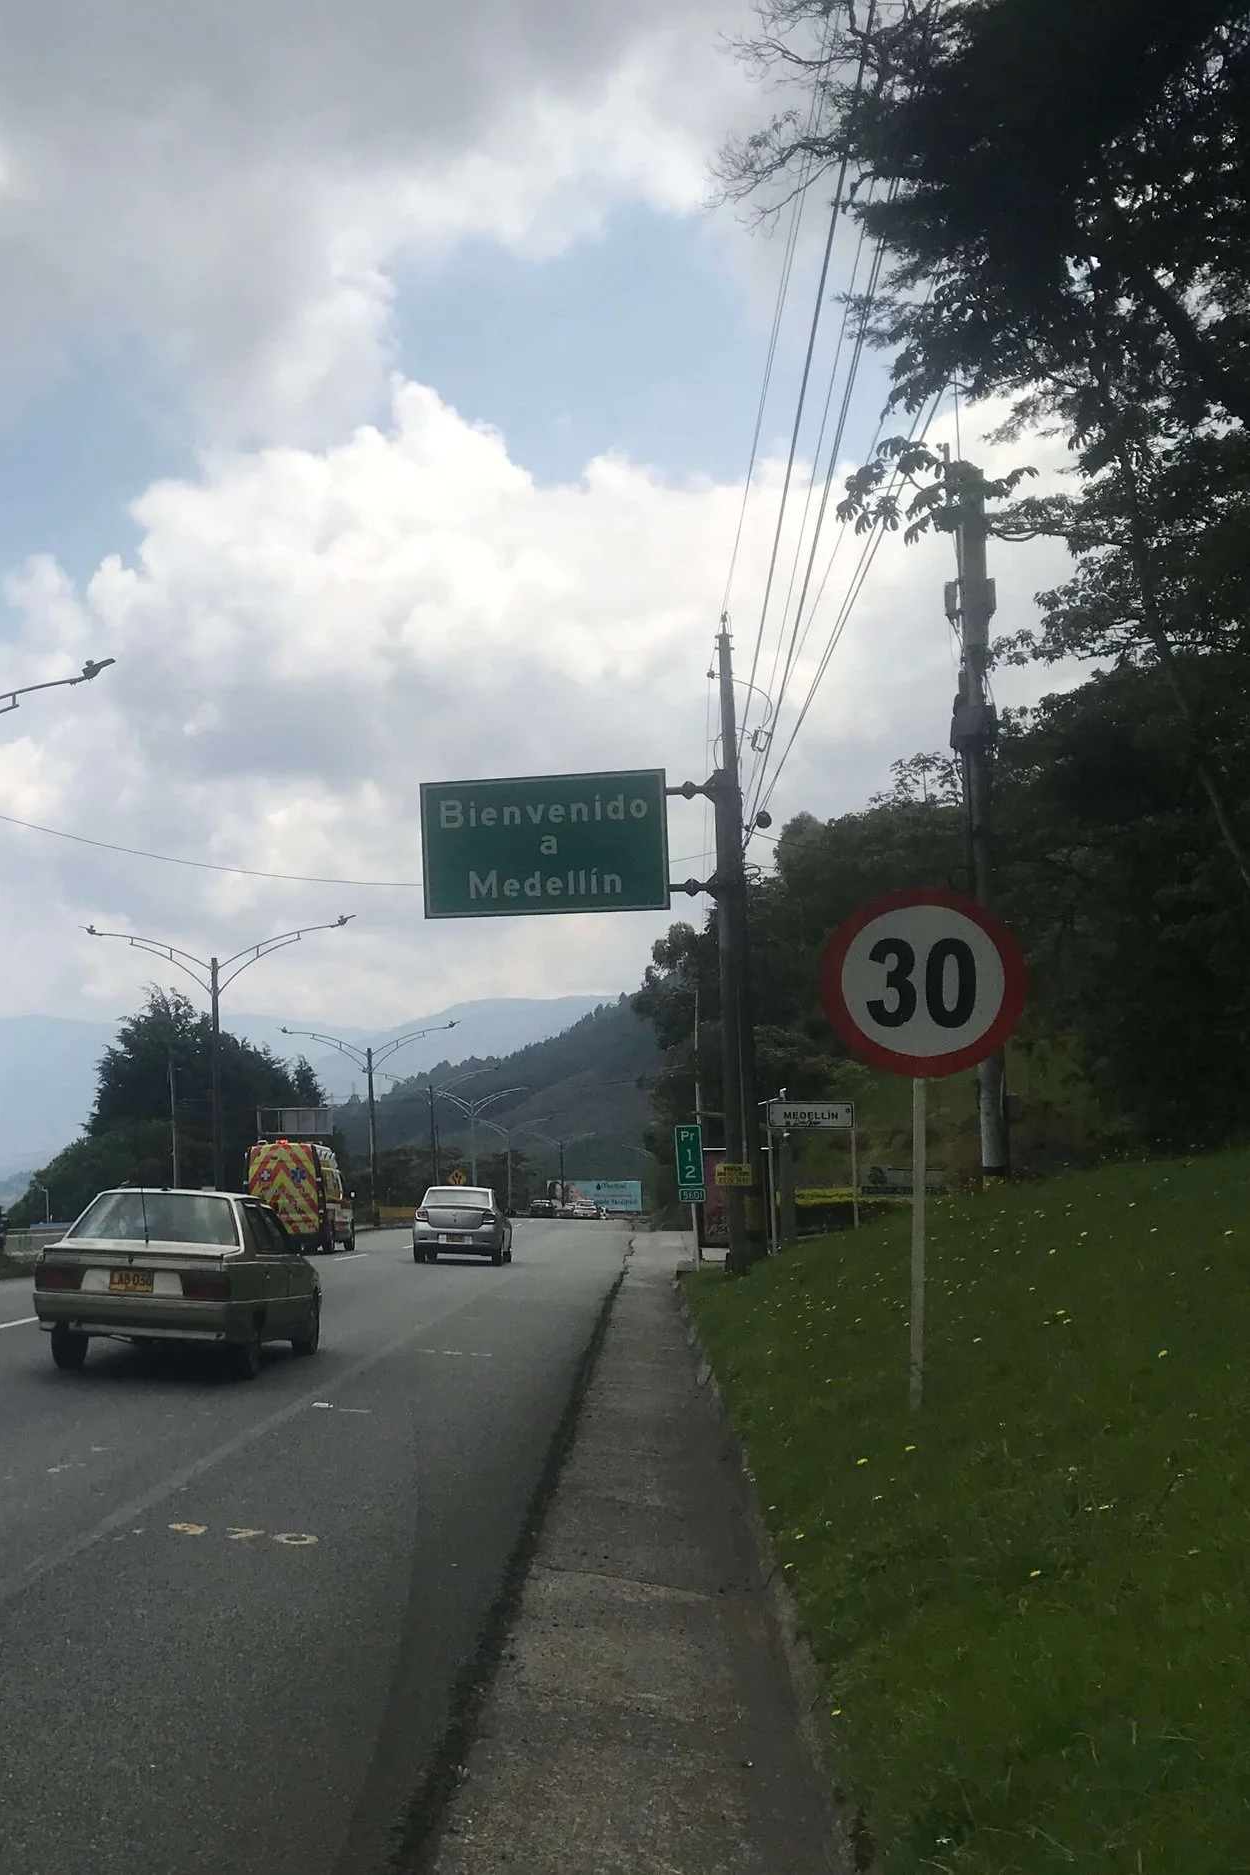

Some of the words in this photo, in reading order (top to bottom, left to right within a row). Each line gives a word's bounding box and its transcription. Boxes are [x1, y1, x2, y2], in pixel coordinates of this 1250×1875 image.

[438, 794, 648, 829] Bienvenido
[539, 833, 558, 856] a
[468, 868, 622, 899] Medellín
[866, 937, 977, 1029] 30
[680, 1130, 695, 1142] Pr
[682, 1190, 703, 1200] 5601
